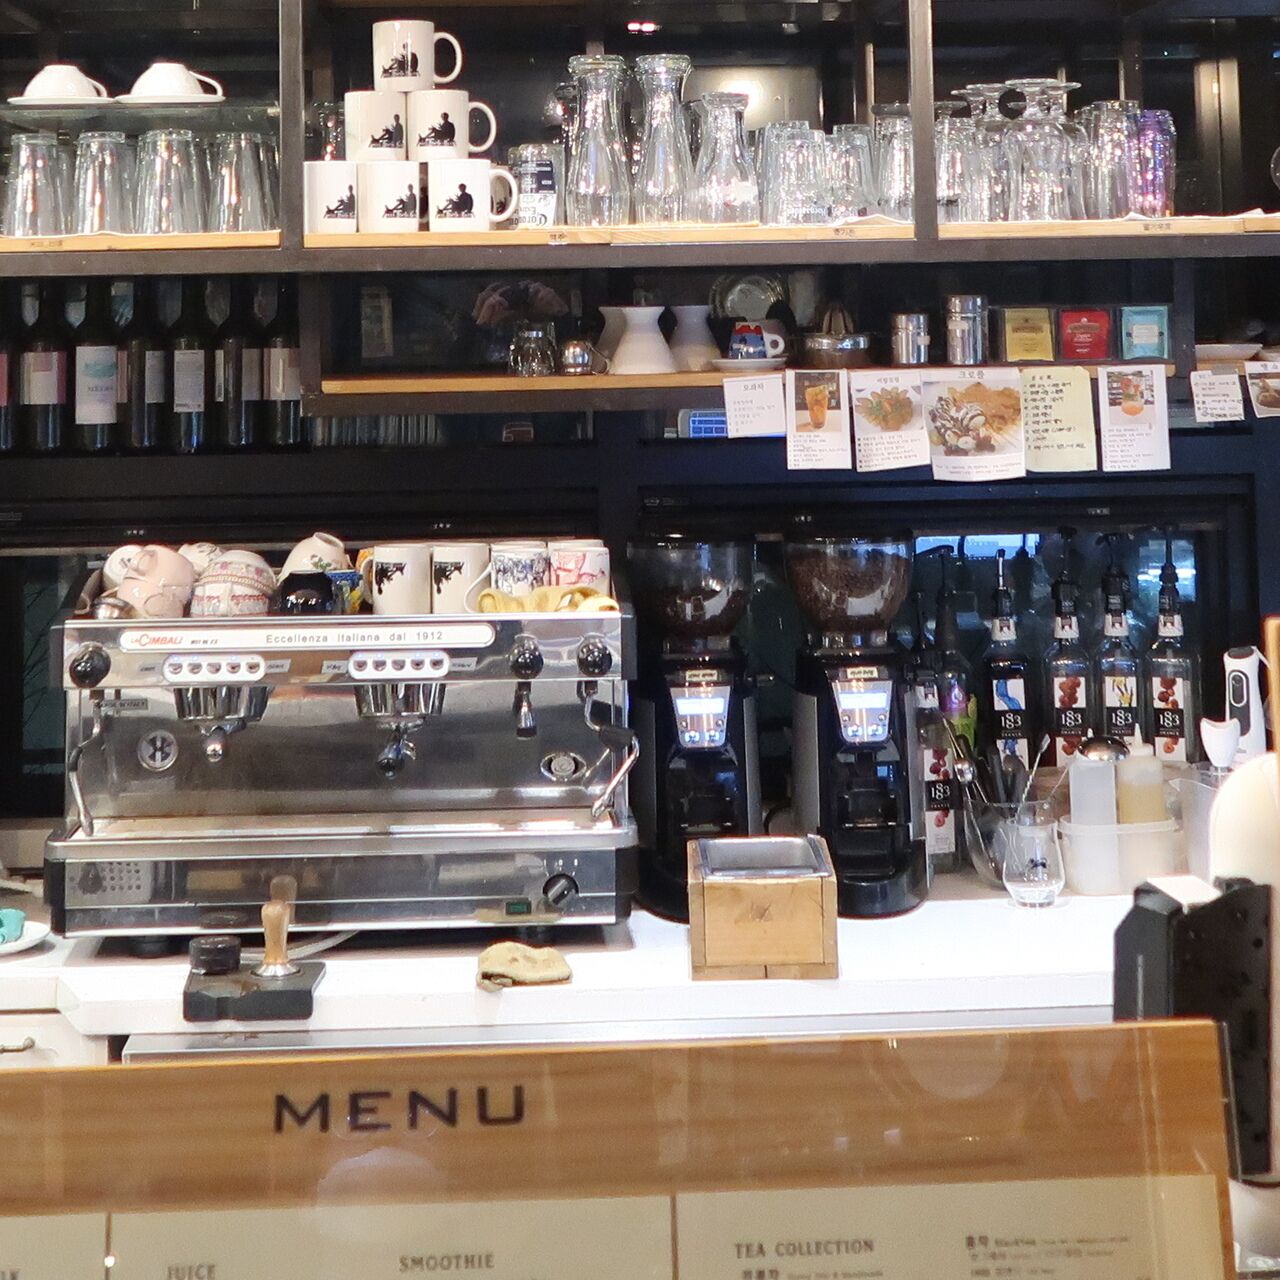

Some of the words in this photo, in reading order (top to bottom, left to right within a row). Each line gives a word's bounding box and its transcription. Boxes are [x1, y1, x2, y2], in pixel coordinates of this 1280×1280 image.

[139, 634, 183, 646] CIMBALI
[265, 634, 328, 644] Eccellenza
[337, 632, 381, 642] Italiana
[388, 631, 406, 641] dal
[416, 630, 443, 640] 1912
[274, 1085, 527, 1133] MENU
[735, 1242, 766, 1259] TEA
[775, 1239, 874, 1257] COLLECTION
[167, 1264, 217, 1280] JUICE
[398, 1254, 495, 1273] SMOOTHIE
